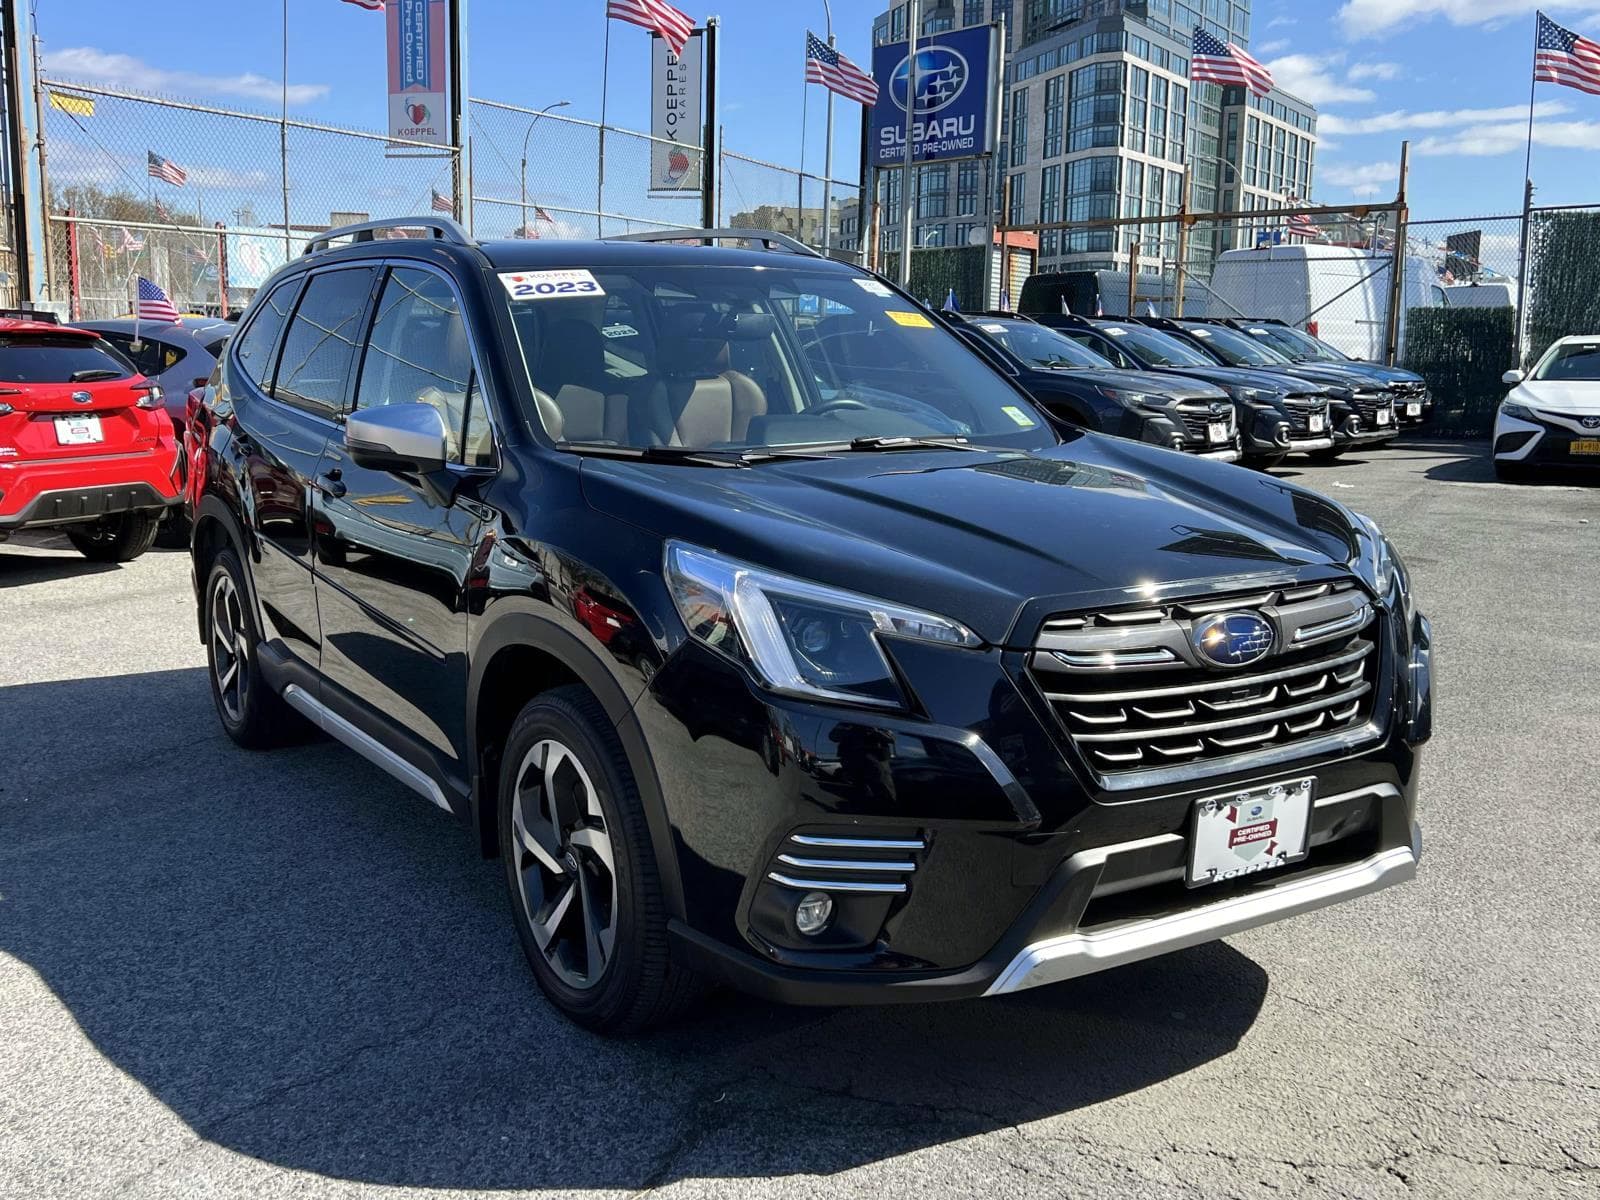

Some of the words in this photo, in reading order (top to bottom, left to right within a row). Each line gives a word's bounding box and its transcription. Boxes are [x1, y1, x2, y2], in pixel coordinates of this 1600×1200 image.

[405, 0, 414, 82] Pre-Owned
[415, 1, 424, 80] CERTIFIED
[666, 49, 678, 142] KOEPPE
[678, 63, 687, 119] KARES
[398, 127, 437, 136] KOEPPEL
[880, 114, 975, 146] SUBARU
[880, 144, 919, 158] CERTIFD
[922, 137, 974, 154] PRE-OWNED
[513, 281, 598, 296] 2023
[1233, 830, 1272, 844] PRE-OWNED
[1237, 824, 1270, 836] CERTIFIED
